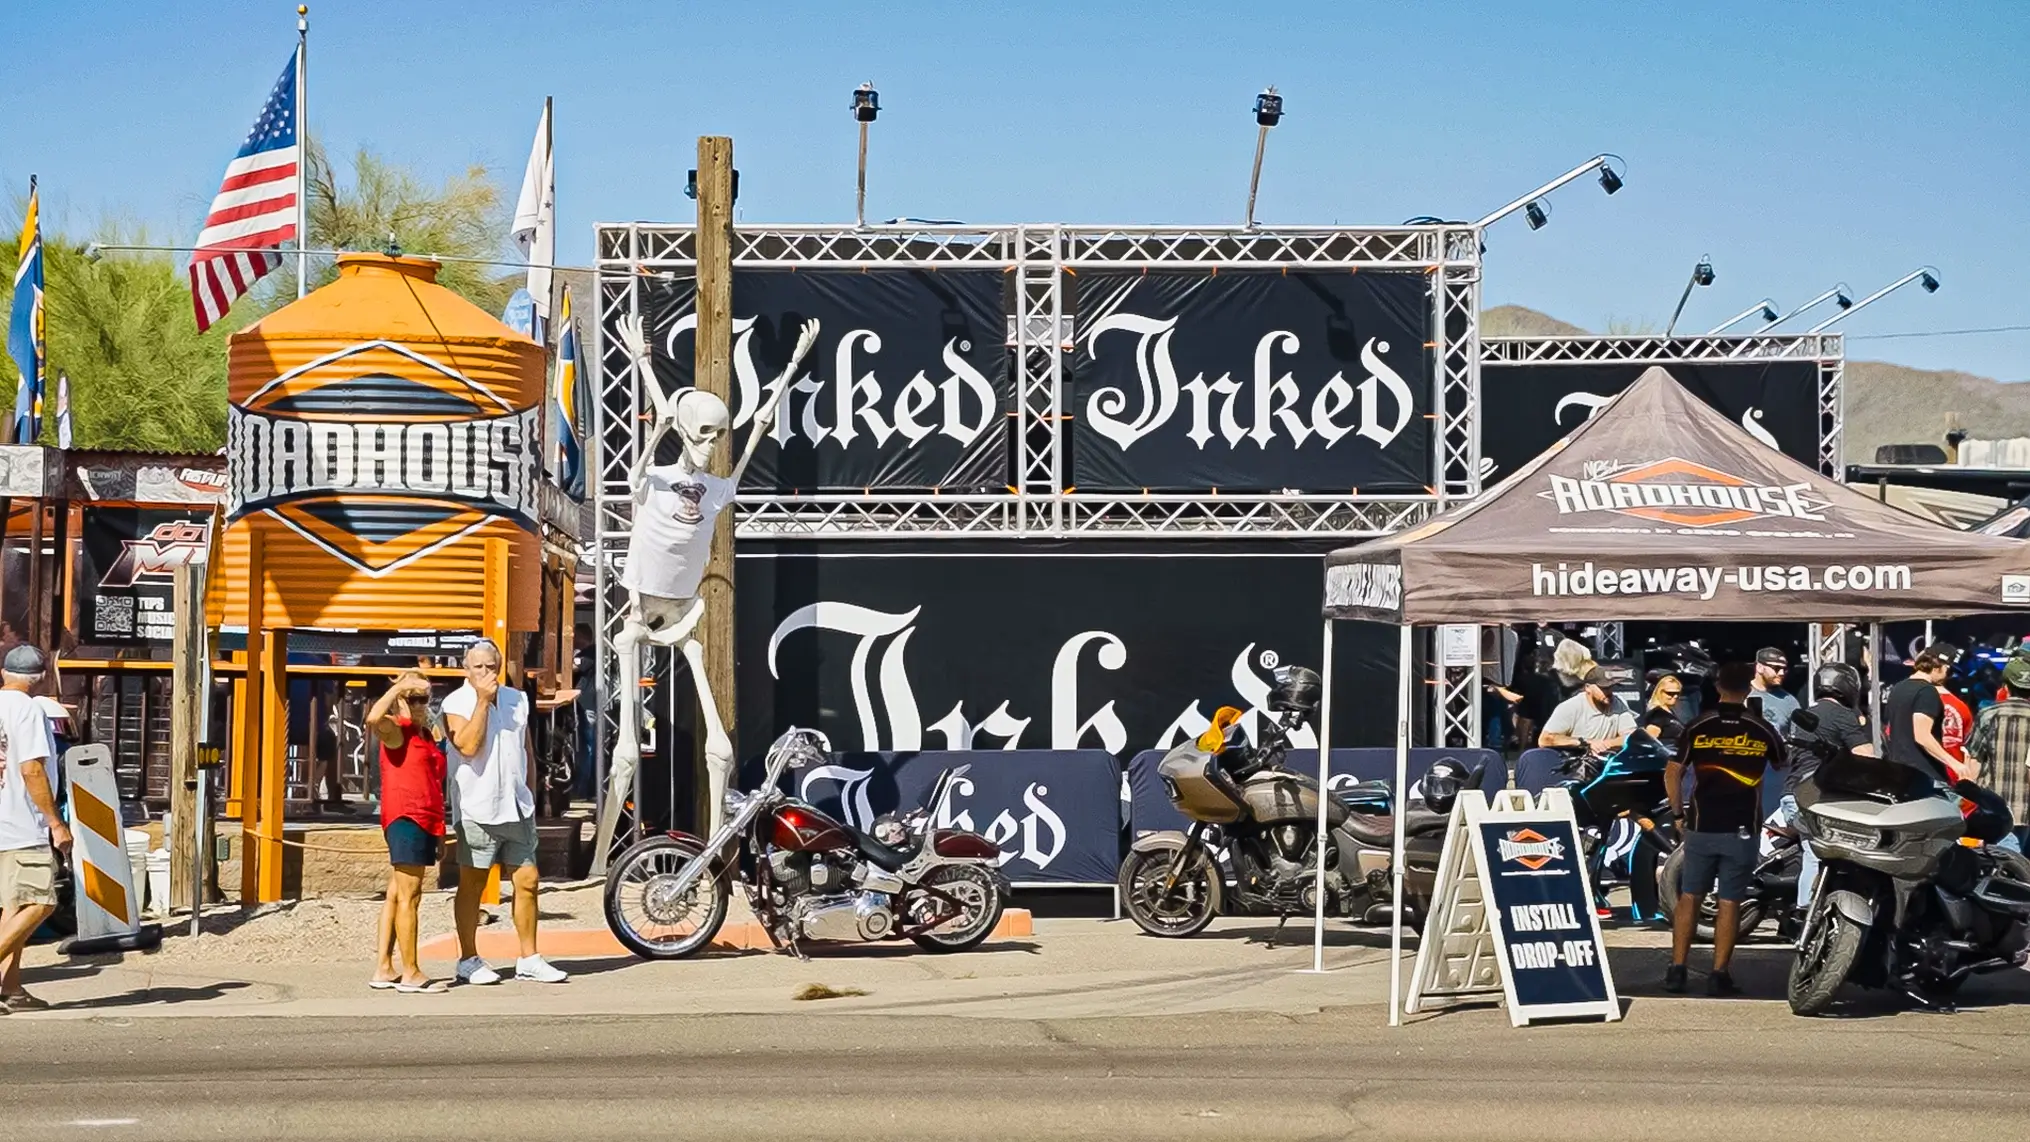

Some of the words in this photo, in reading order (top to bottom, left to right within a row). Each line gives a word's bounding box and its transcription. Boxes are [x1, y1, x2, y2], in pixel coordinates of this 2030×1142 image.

[1086, 313, 1413, 451] Inked
[1549, 474, 1826, 521] ROADHOUSE
[1532, 562, 1912, 600] hideaway-usa.com
[1510, 903, 1581, 931] INSTALL
[1511, 940, 1594, 969] DROP-OFF
